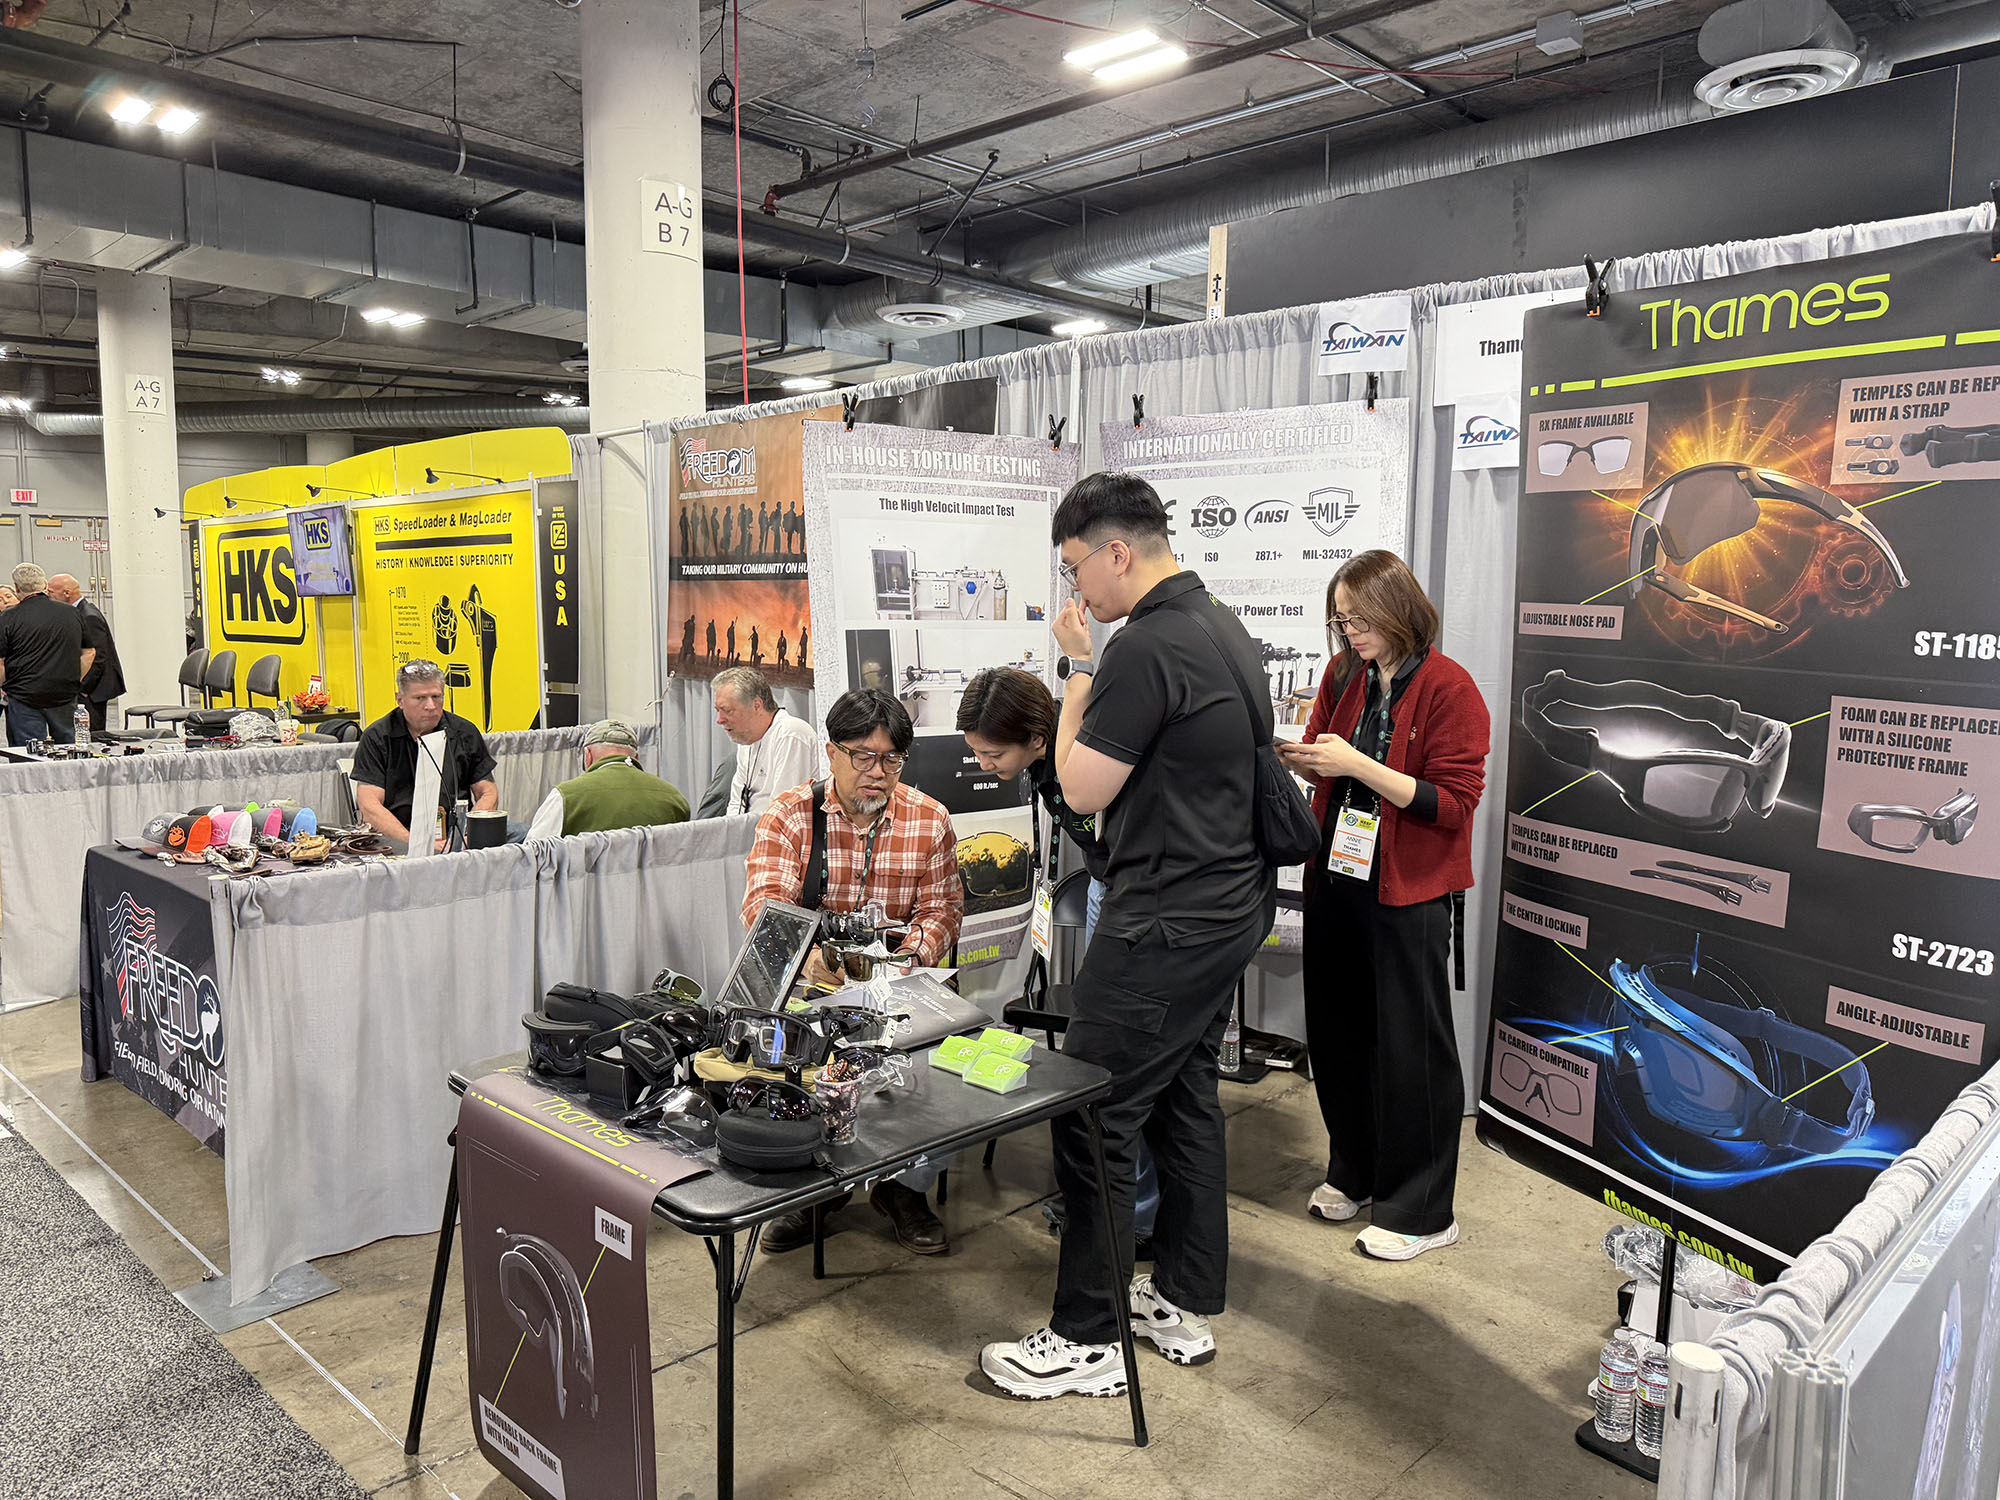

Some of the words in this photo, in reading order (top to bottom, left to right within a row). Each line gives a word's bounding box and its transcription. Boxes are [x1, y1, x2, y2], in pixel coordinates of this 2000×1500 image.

[654, 192, 692, 219] A-G
[658, 222, 672, 243] B
[679, 226, 690, 247] 7
[1639, 273, 1891, 350] Thames
[1321, 333, 1405, 352] TAIWAN
[1479, 338, 1525, 357] Tham
[133, 379, 161, 393] A-G
[1852, 383, 1913, 402] TEMPLES
[1915, 380, 1947, 397] CAN
[1949, 378, 1970, 394] BE
[136, 395, 148, 408] A
[151, 396, 160, 409] 7
[1849, 406, 1888, 423] WITH
[1888, 405, 1899, 420] A
[1902, 402, 1951, 420] STRAP
[1539, 419, 1550, 432] RX
[1551, 416, 1583, 431] FRAME
[1583, 412, 1635, 428] AVAILABLE
[1123, 430, 1260, 460] INTERNATIONALLY
[1261, 424, 1354, 450] CERTIFIED
[686, 445, 757, 484] FREEDOM
[826, 445, 908, 468] IN-HOUSE
[911, 449, 982, 473] TORTURE
[983, 455, 1042, 478] TESTING
[15, 490, 33, 502] EXIT
[878, 497, 899, 511] The
[900, 498, 924, 514] High
[925, 500, 961, 515] Velocit
[962, 502, 995, 517] Impact
[995, 504, 1015, 518] Test
[374, 518, 389, 533] HKS
[393, 514, 448, 533] SpeedLoader
[449, 513, 456, 527] &
[459, 509, 512, 529] MagLoader
[1190, 507, 1237, 529] ISO
[1253, 509, 1290, 524] ANSI
[1317, 502, 1343, 524] MIL
[305, 522, 329, 545] HKS
[375, 558, 404, 570] HISTORY
[409, 555, 454, 569] KNOWLEDGE
[459, 553, 514, 567] SUPERIORITY
[681, 564, 703, 576] TAKING
[703, 564, 717, 575] OUR
[741, 562, 785, 575] COMMUNITY
[785, 562, 798, 574] ON
[1204, 551, 1219, 563] ISO
[1255, 550, 1283, 561] Z87.1+
[1302, 548, 1353, 560] MIL-32432
[223, 546, 298, 624] HKS
[553, 554, 569, 627] USA
[1244, 604, 1278, 618] Power
[1280, 604, 1304, 617] Test
[1522, 612, 1568, 627] ADJUSTABLE
[1569, 614, 1594, 628] NOSE
[1595, 615, 1616, 629] PAD
[1840, 706, 1877, 723] FOAM
[1879, 709, 1907, 727] CAN
[1909, 712, 1928, 728] BE
[1929, 714, 2000, 736] REPLACE
[1839, 726, 1874, 744] WITH
[1875, 730, 1885, 746] A
[1887, 732, 1953, 753] SILICONE
[1837, 746, 1916, 771] PROTECTIVE
[1917, 756, 1969, 777] FRAME
[1511, 823, 1540, 842] TEMPLES
[1540, 831, 1558, 847] CAN
[1558, 835, 1571, 850] BE
[1571, 838, 1619, 860] REPLACED
[1511, 840, 1527, 855] WITH
[1527, 844, 1533, 857] A
[1533, 846, 1560, 864] STRAP
[1505, 901, 1517, 916] THE
[1516, 906, 1544, 926] CENTER
[1544, 916, 1582, 938] LOCKING
[1891, 932, 1995, 977] ST-2723
[124, 941, 228, 1067] FREEDO
[1836, 1000, 1971, 1050] ANGLE-ADJUSTABLE
[1507, 1034, 1539, 1058] CARRIER
[1539, 1048, 1590, 1080] COMPATIBLE
[532, 1095, 641, 1148] Thames
[601, 1217, 626, 1245] FRAME
[1602, 1187, 1755, 1282] thames.com.tw
[484, 1404, 519, 1443] REMOVABLE
[518, 1432, 537, 1457] BACK
[535, 1446, 559, 1476] FRAME
[485, 1421, 503, 1446] WITH
[502, 1434, 521, 1460] FOAM
